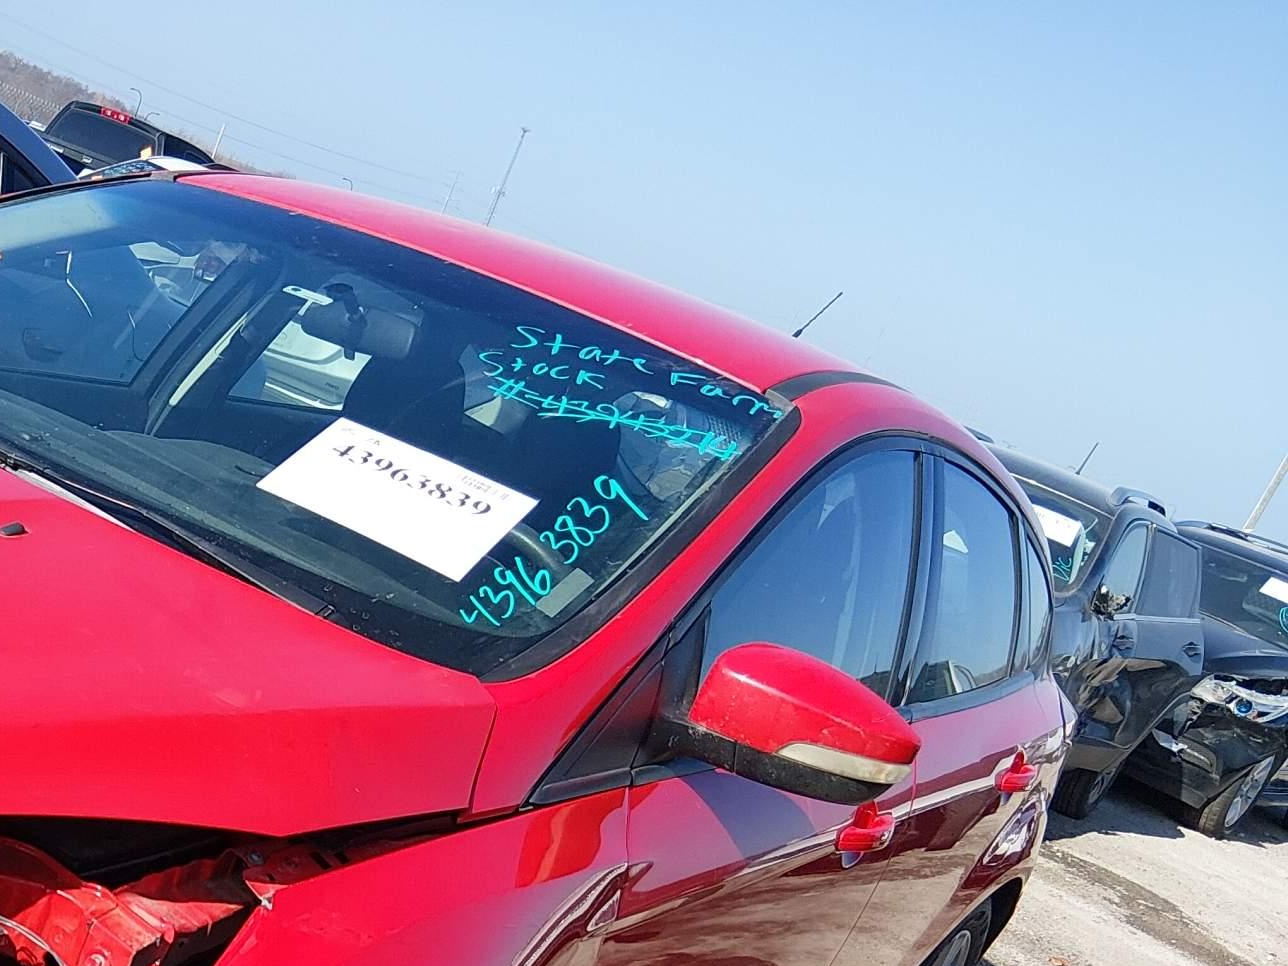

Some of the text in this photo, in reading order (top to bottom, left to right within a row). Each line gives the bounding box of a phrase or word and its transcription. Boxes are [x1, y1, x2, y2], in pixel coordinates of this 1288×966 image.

[510, 325, 654, 375] State
[332, 444, 492, 515] 43963839
[459, 474, 649, 627] 4396 3839
